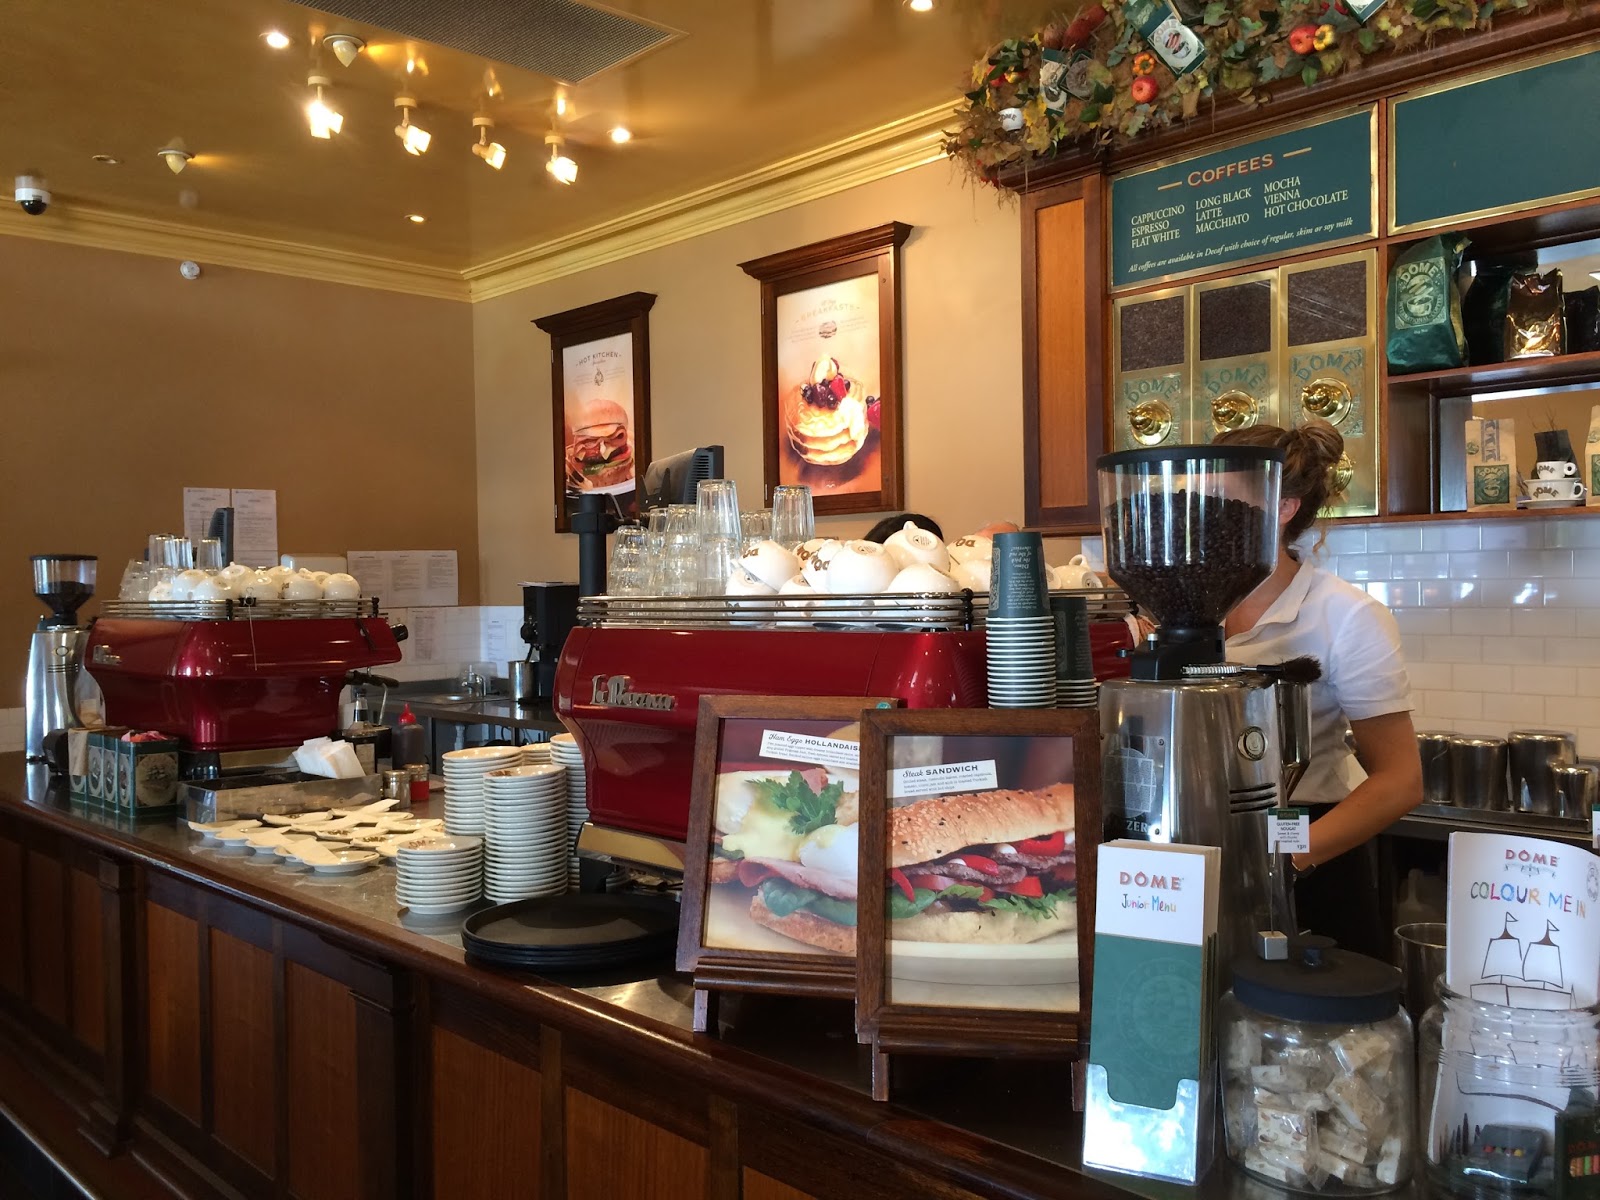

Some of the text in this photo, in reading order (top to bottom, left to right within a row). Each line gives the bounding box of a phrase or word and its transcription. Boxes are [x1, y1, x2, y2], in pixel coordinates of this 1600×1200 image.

[1187, 153, 1274, 187] COFFEES
[1263, 176, 1301, 193] MOCHA
[1195, 187, 1252, 210] LONG BLACK
[1263, 189, 1301, 205] VIENNA
[1264, 190, 1349, 218] HOT CHOCOLATE
[1131, 204, 1185, 226] CAPPUCCINO
[1195, 207, 1223, 222] LATTE
[1195, 212, 1250, 234] MACCHIATO
[1131, 220, 1170, 237] ESPRESSO
[1131, 228, 1181, 249] FLAT WHITE
[1128, 264, 1138, 273] All
[1138, 260, 1156, 272] coffees
[1167, 252, 1195, 264] available
[1204, 245, 1224, 257] Decaf
[1224, 242, 1240, 252] with
[1240, 238, 1260, 249] choice
[1261, 234, 1270, 246] of
[1269, 231, 1295, 244] regular,
[1296, 227, 1313, 237] skim
[1314, 225, 1322, 233] or
[1323, 223, 1335, 232] soy
[1336, 217, 1353, 228] milk
[592, 351, 618, 360] KITCHEN
[804, 738, 861, 752] HOLLANDAIS
[902, 770, 924, 778] Steak
[925, 765, 979, 776] SANDWICH
[1121, 893, 1177, 913] Junior Menu
[1470, 881, 1586, 919] COLOUR ME IN
